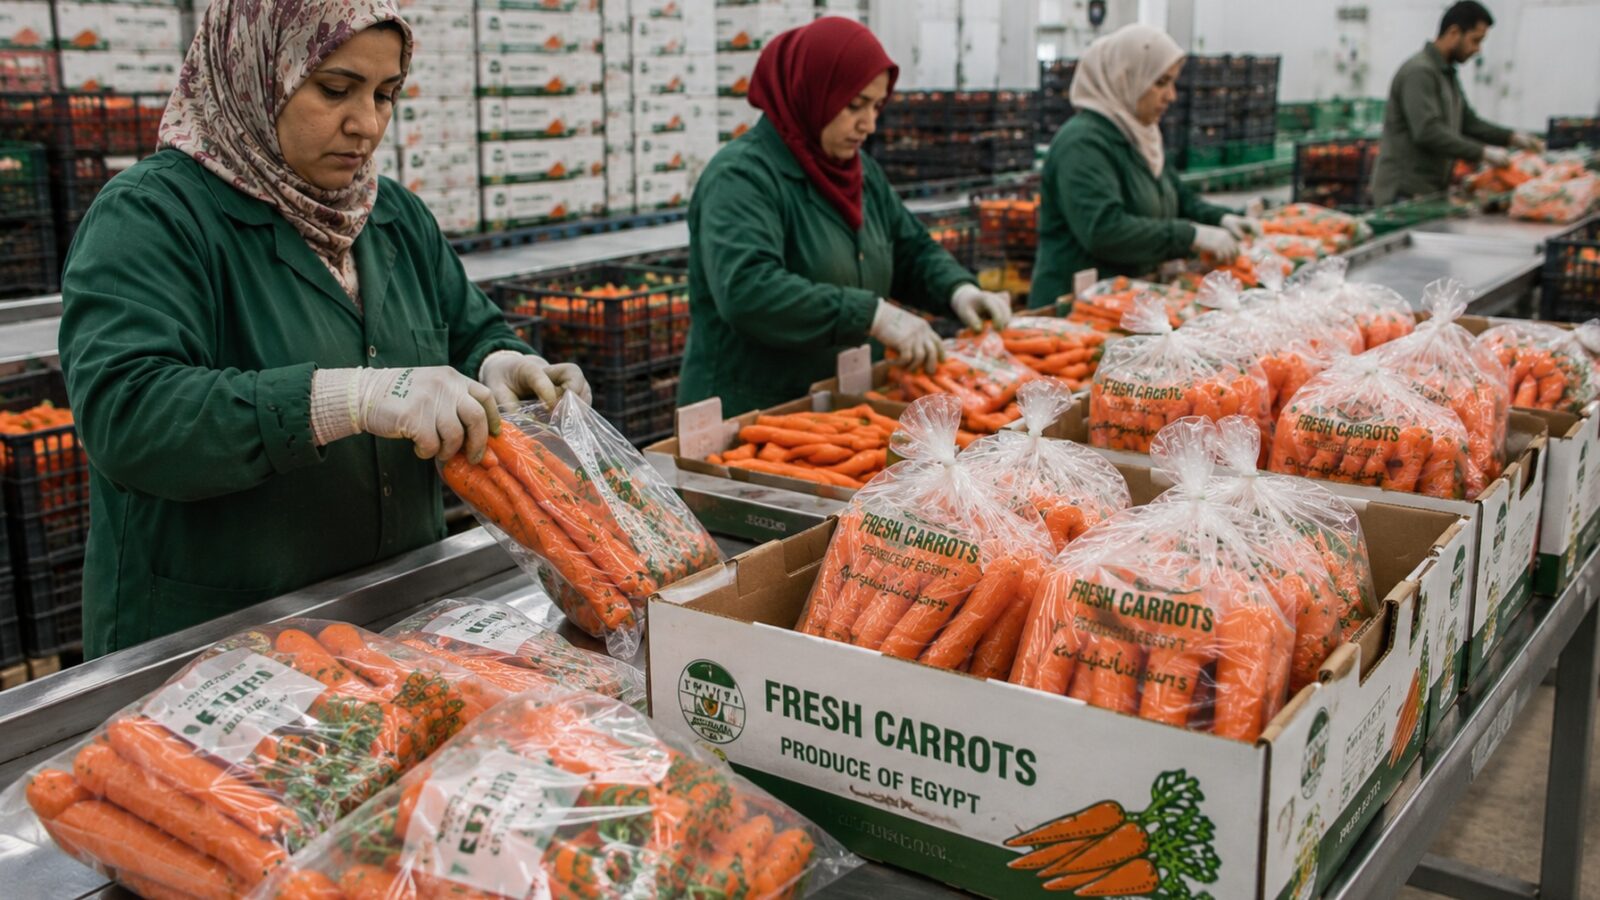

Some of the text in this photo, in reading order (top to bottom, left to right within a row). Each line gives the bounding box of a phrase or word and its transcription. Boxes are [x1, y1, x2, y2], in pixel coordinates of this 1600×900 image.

[858, 512, 904, 542] FRESH
[903, 525, 980, 564] CARROTS
[1067, 579, 1117, 613] FRESH
[1118, 591, 1214, 633] CARROTS
[765, 679, 1038, 787] FRESH CARROTS
[780, 736, 981, 815] PRODUCE OF EGYPT
